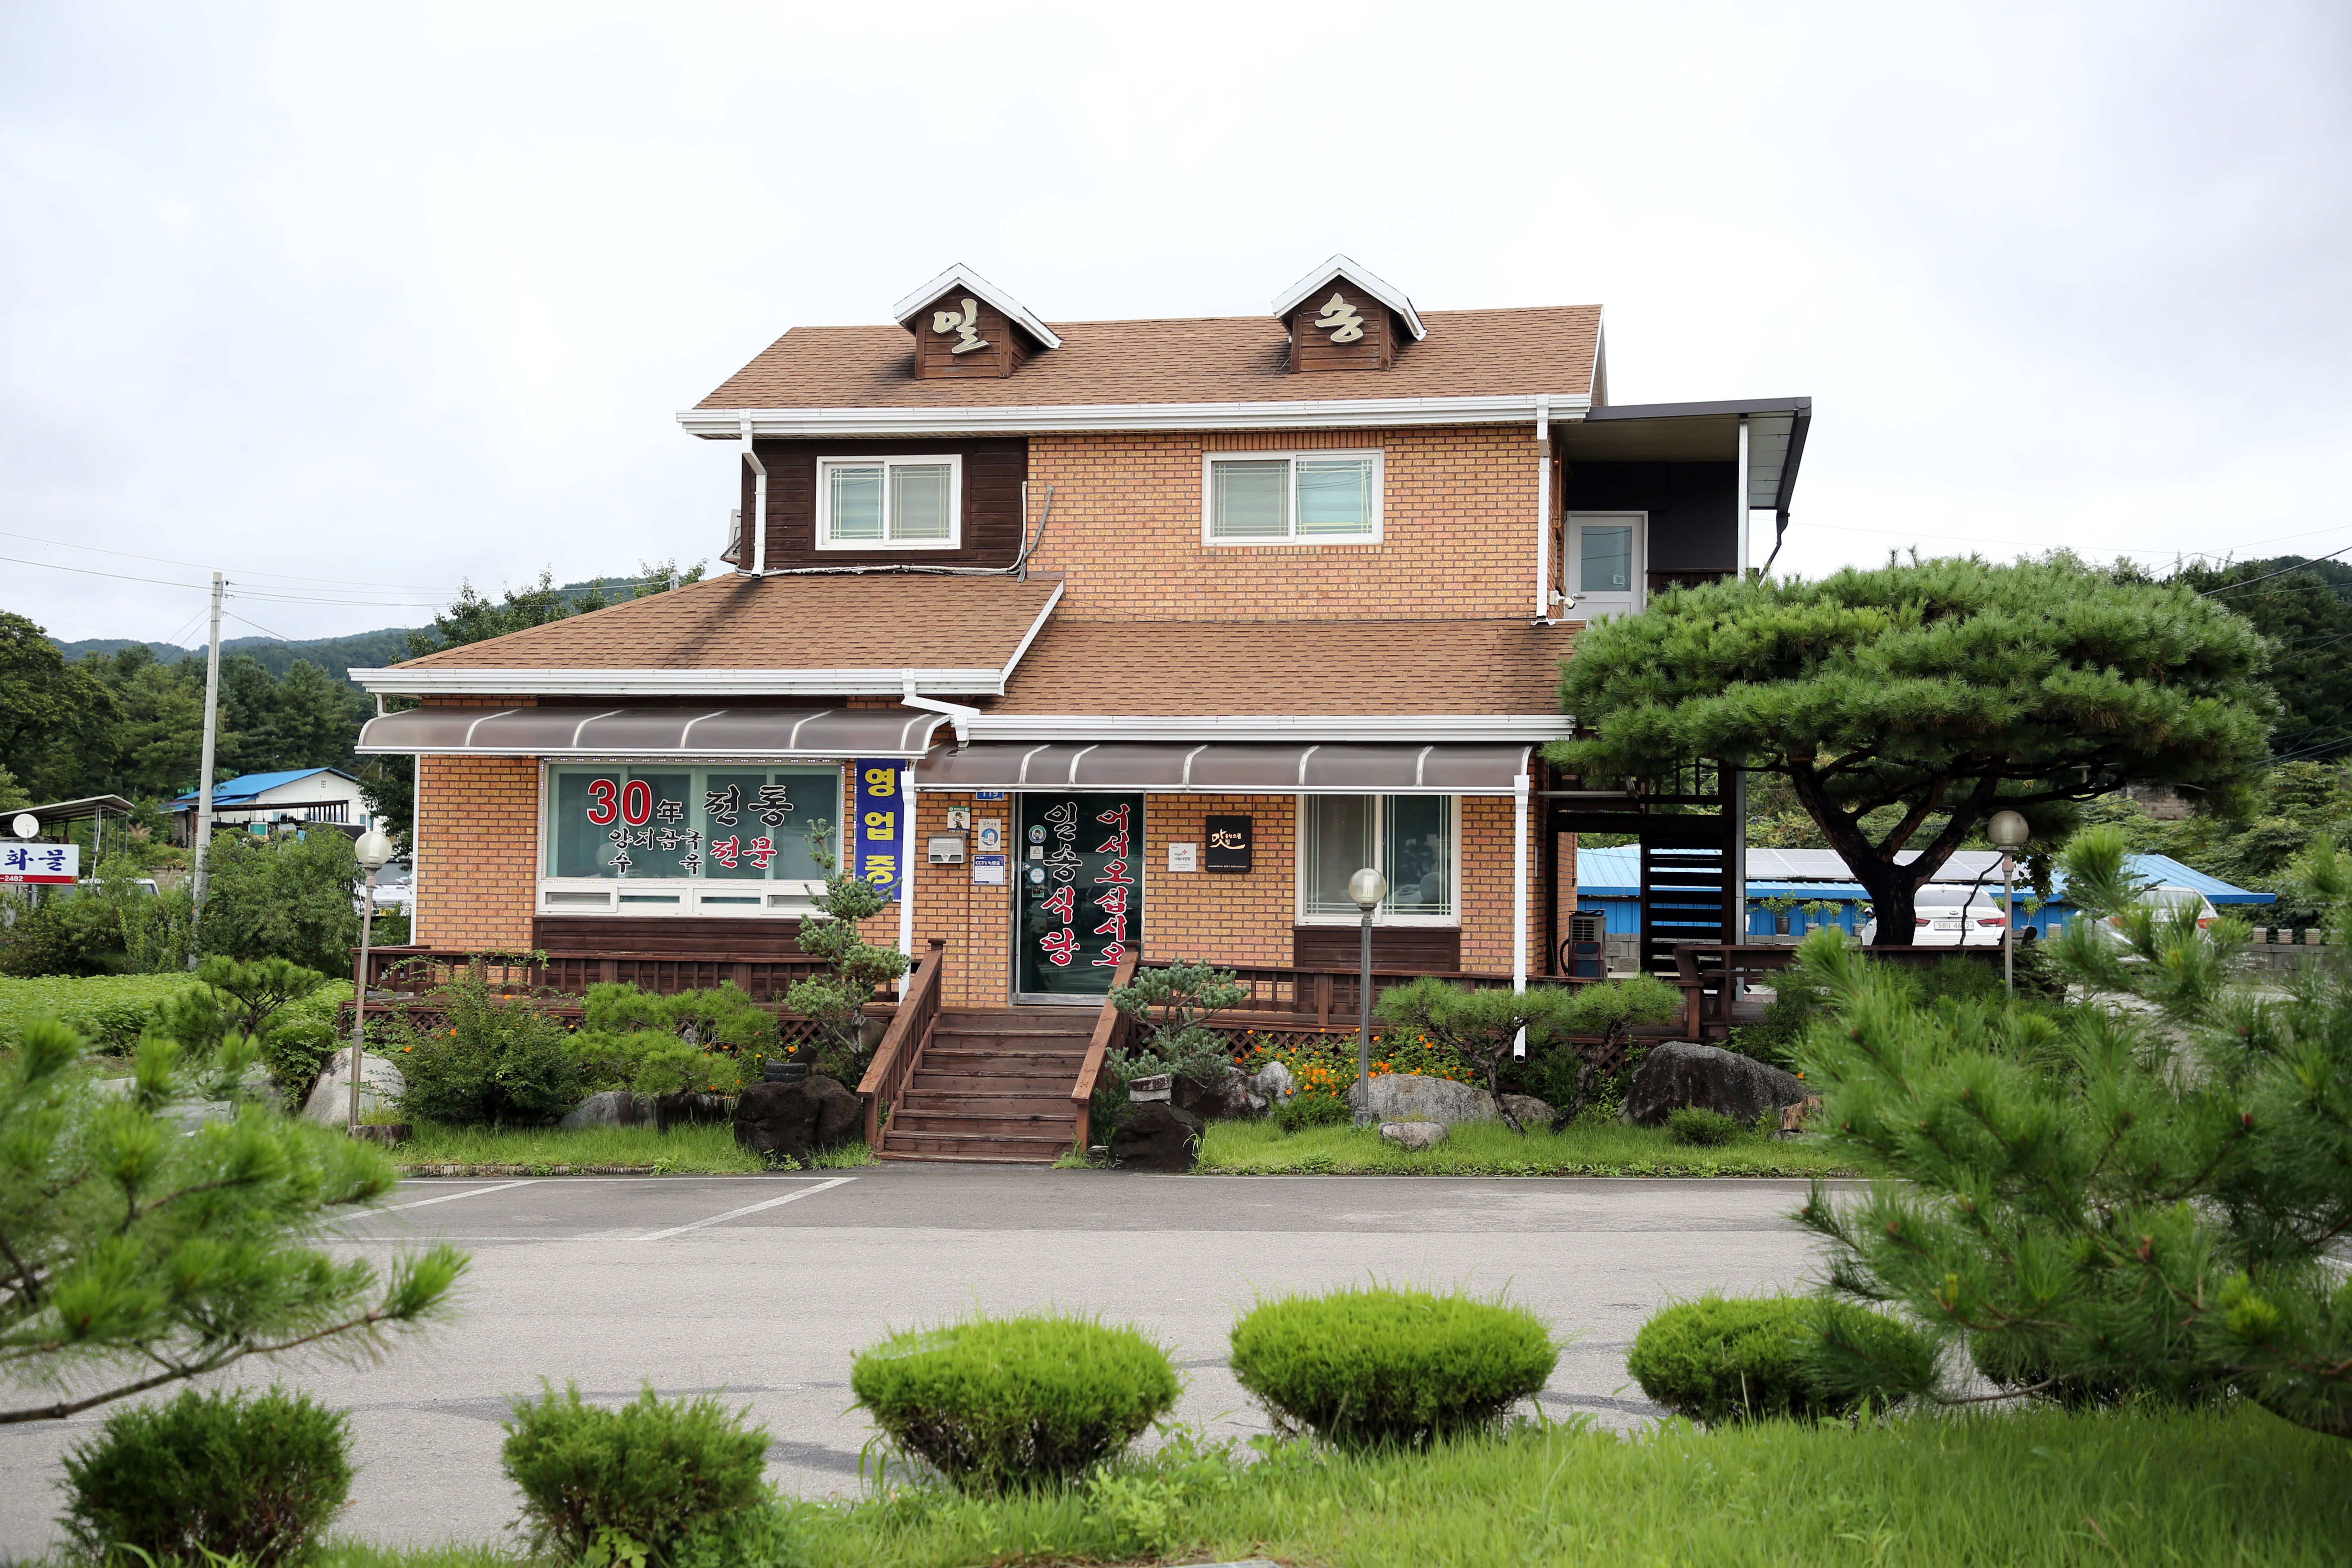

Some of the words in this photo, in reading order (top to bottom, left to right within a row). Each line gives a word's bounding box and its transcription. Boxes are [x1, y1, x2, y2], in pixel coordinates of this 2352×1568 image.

[703, 784, 794, 828] 전통
[608, 826, 704, 851] 양지곰국
[864, 768, 896, 884] 영업중
[4, 848, 67, 871] 화물
[709, 835, 777, 869] 전문
[1091, 803, 1135, 967] 어서오십시오
